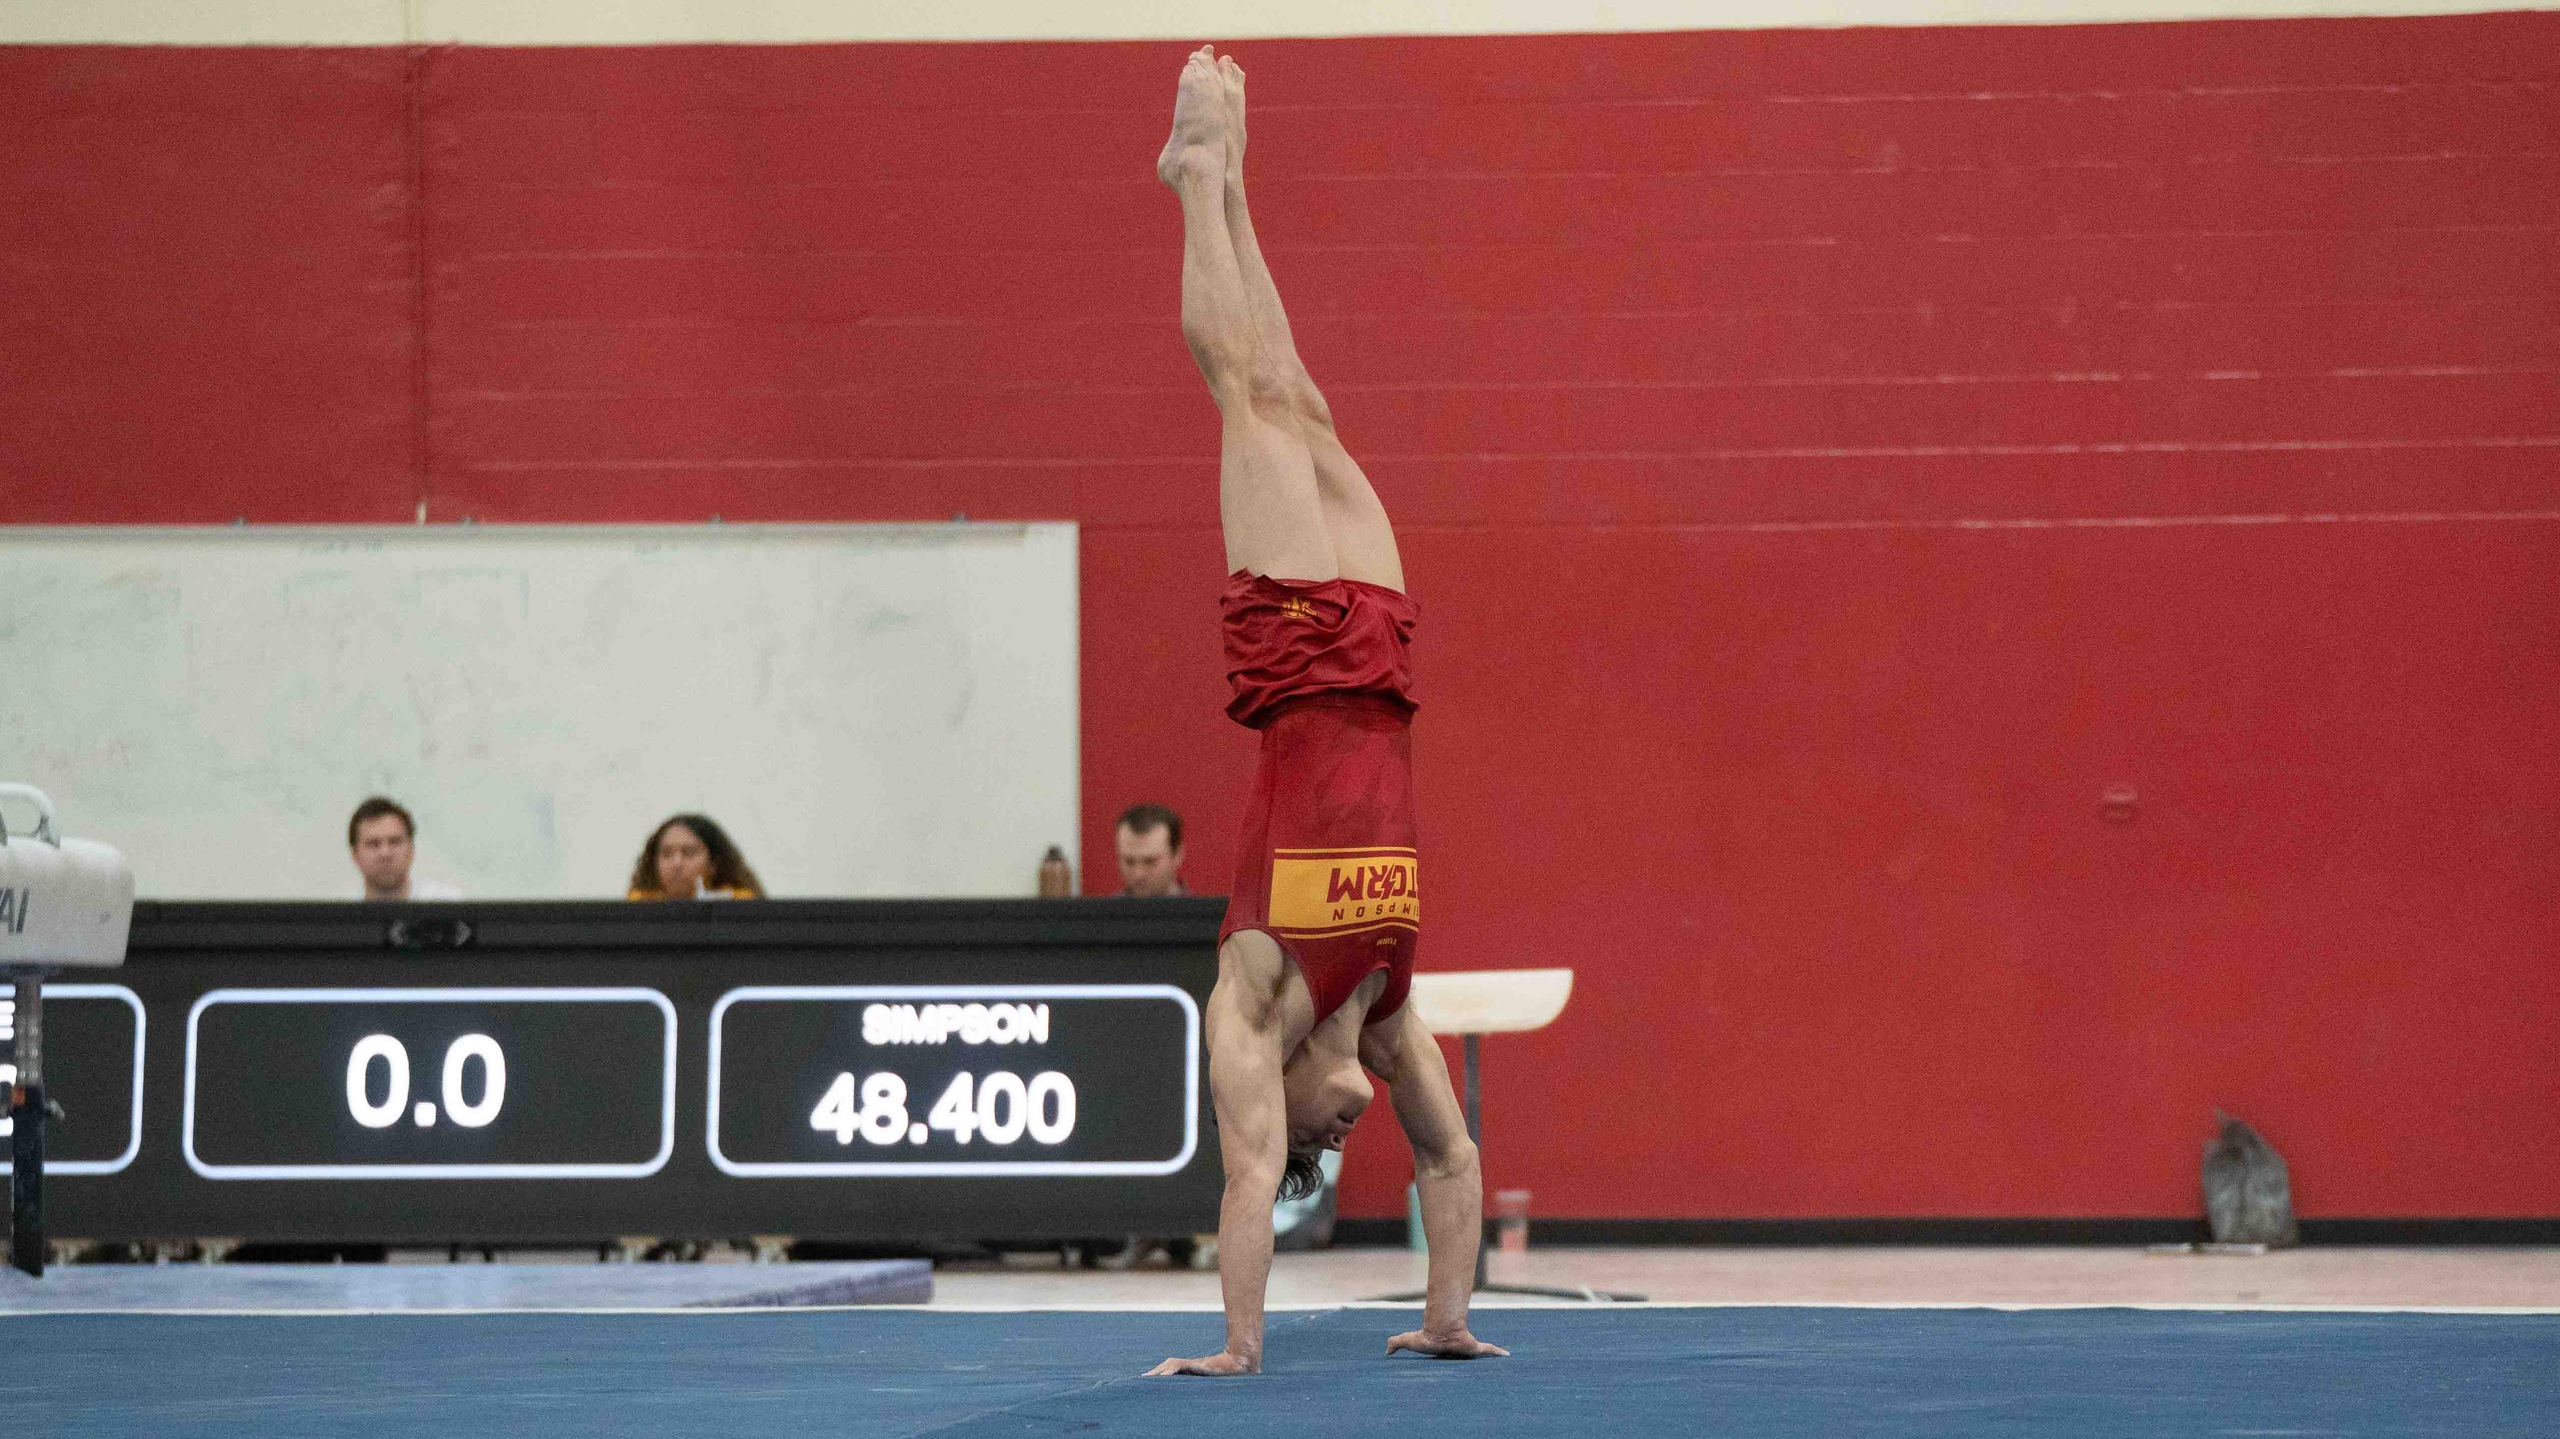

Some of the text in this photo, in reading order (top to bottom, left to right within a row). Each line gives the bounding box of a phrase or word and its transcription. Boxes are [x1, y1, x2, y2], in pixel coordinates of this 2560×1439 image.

[1326, 863, 1419, 903] TORM
[862, 1003, 1049, 1045] SIMPSON
[346, 1033, 506, 1129] 0.0
[810, 1071, 1077, 1145] 48.400
